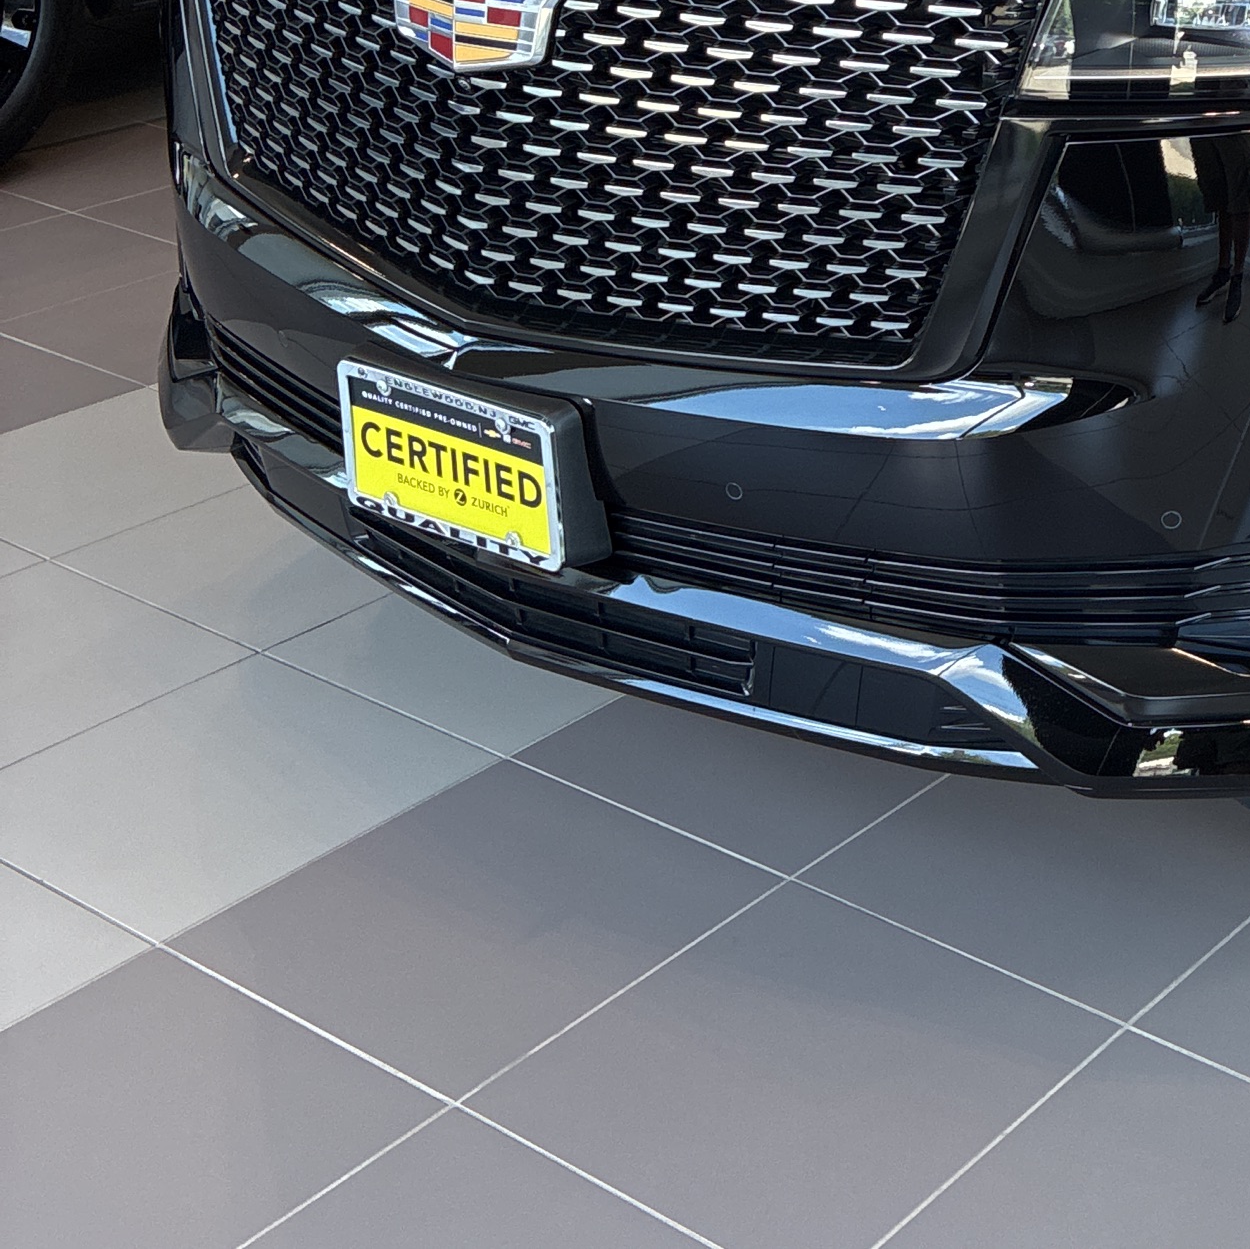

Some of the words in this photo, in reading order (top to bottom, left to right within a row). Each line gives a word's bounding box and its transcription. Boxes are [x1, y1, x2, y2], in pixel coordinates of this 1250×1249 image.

[361, 390, 393, 405] QUALITY
[394, 400, 433, 419] CERTIFIED
[433, 410, 478, 433] PRE-OWNED
[507, 414, 537, 432] GMC
[360, 420, 543, 510] CERTIFIED
[397, 472, 436, 495] BACKED
[437, 485, 451, 500] BY
[471, 496, 509, 518] ZURICH
[355, 496, 550, 566] QUALITY
